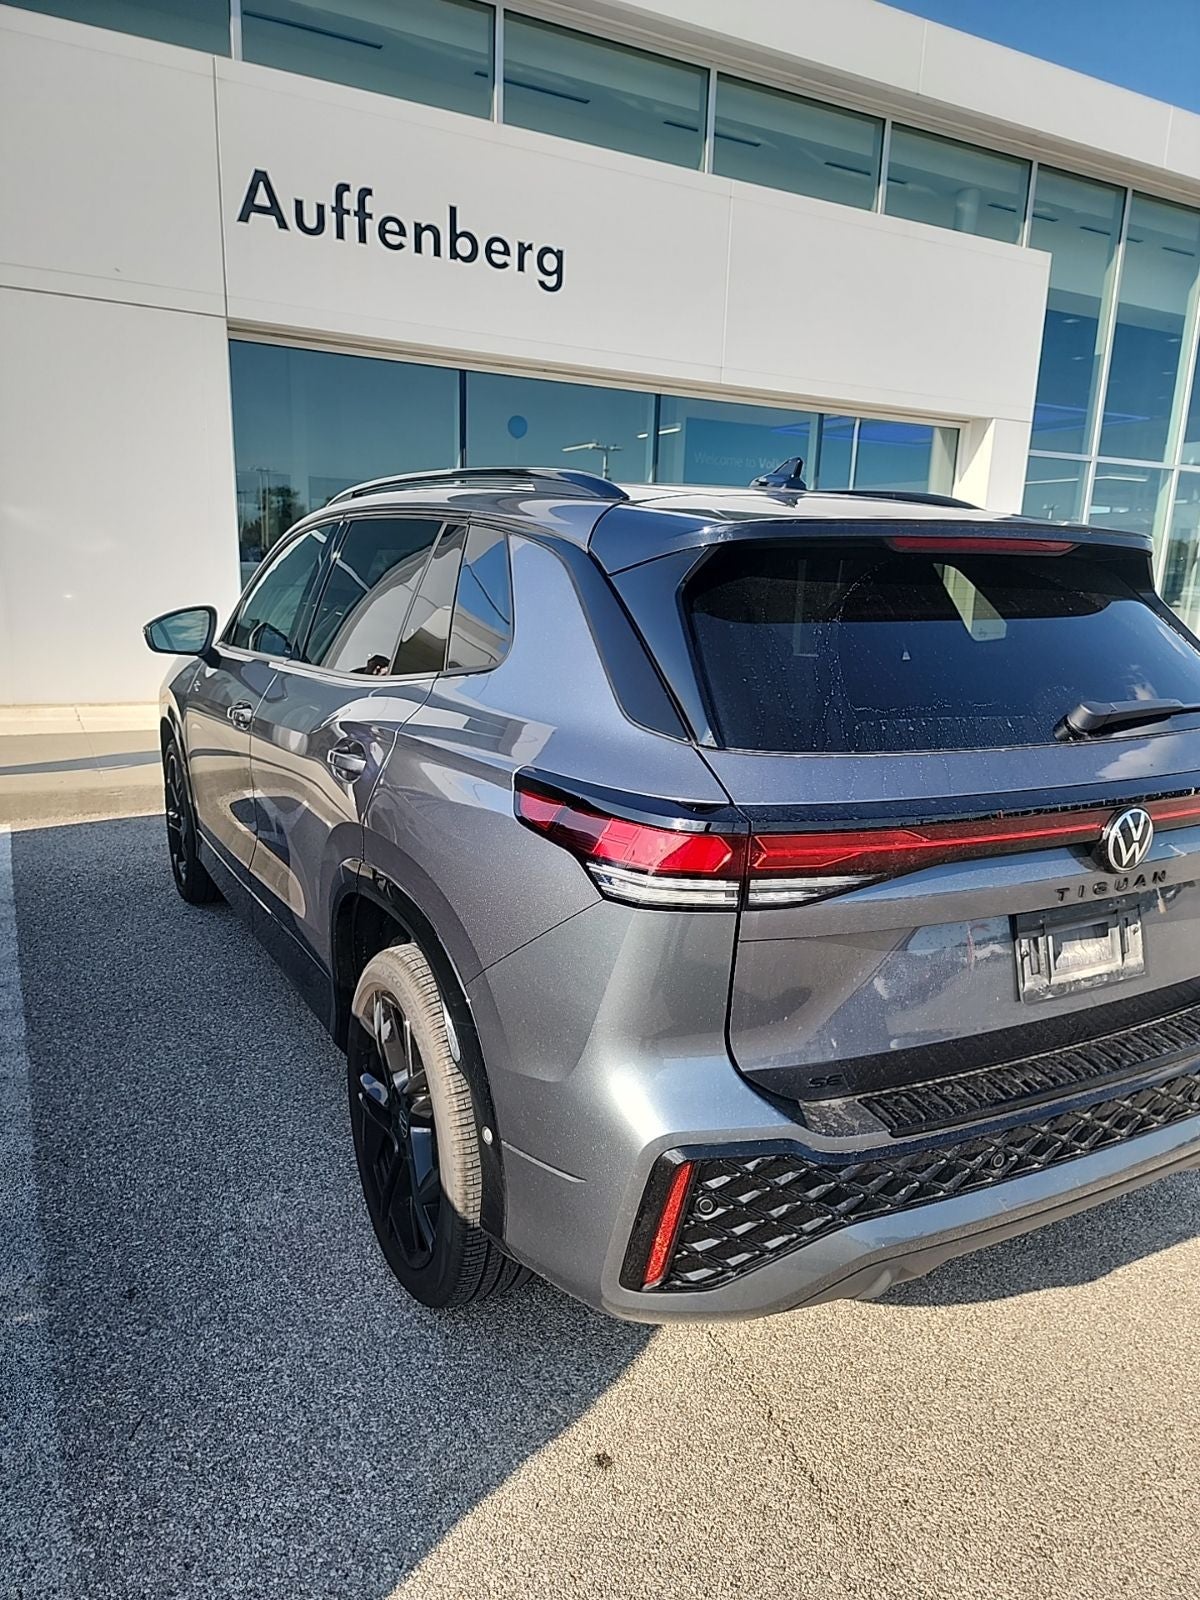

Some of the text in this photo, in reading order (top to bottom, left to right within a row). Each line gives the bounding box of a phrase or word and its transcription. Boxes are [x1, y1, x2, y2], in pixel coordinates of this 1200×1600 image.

[237, 167, 565, 293] Auffenberg
[694, 450, 744, 467] Welcome
[745, 455, 757, 468] to
[1108, 808, 1153, 873] VW
[1056, 870, 1167, 902] TIGUAN
[808, 1073, 843, 1089] SE
